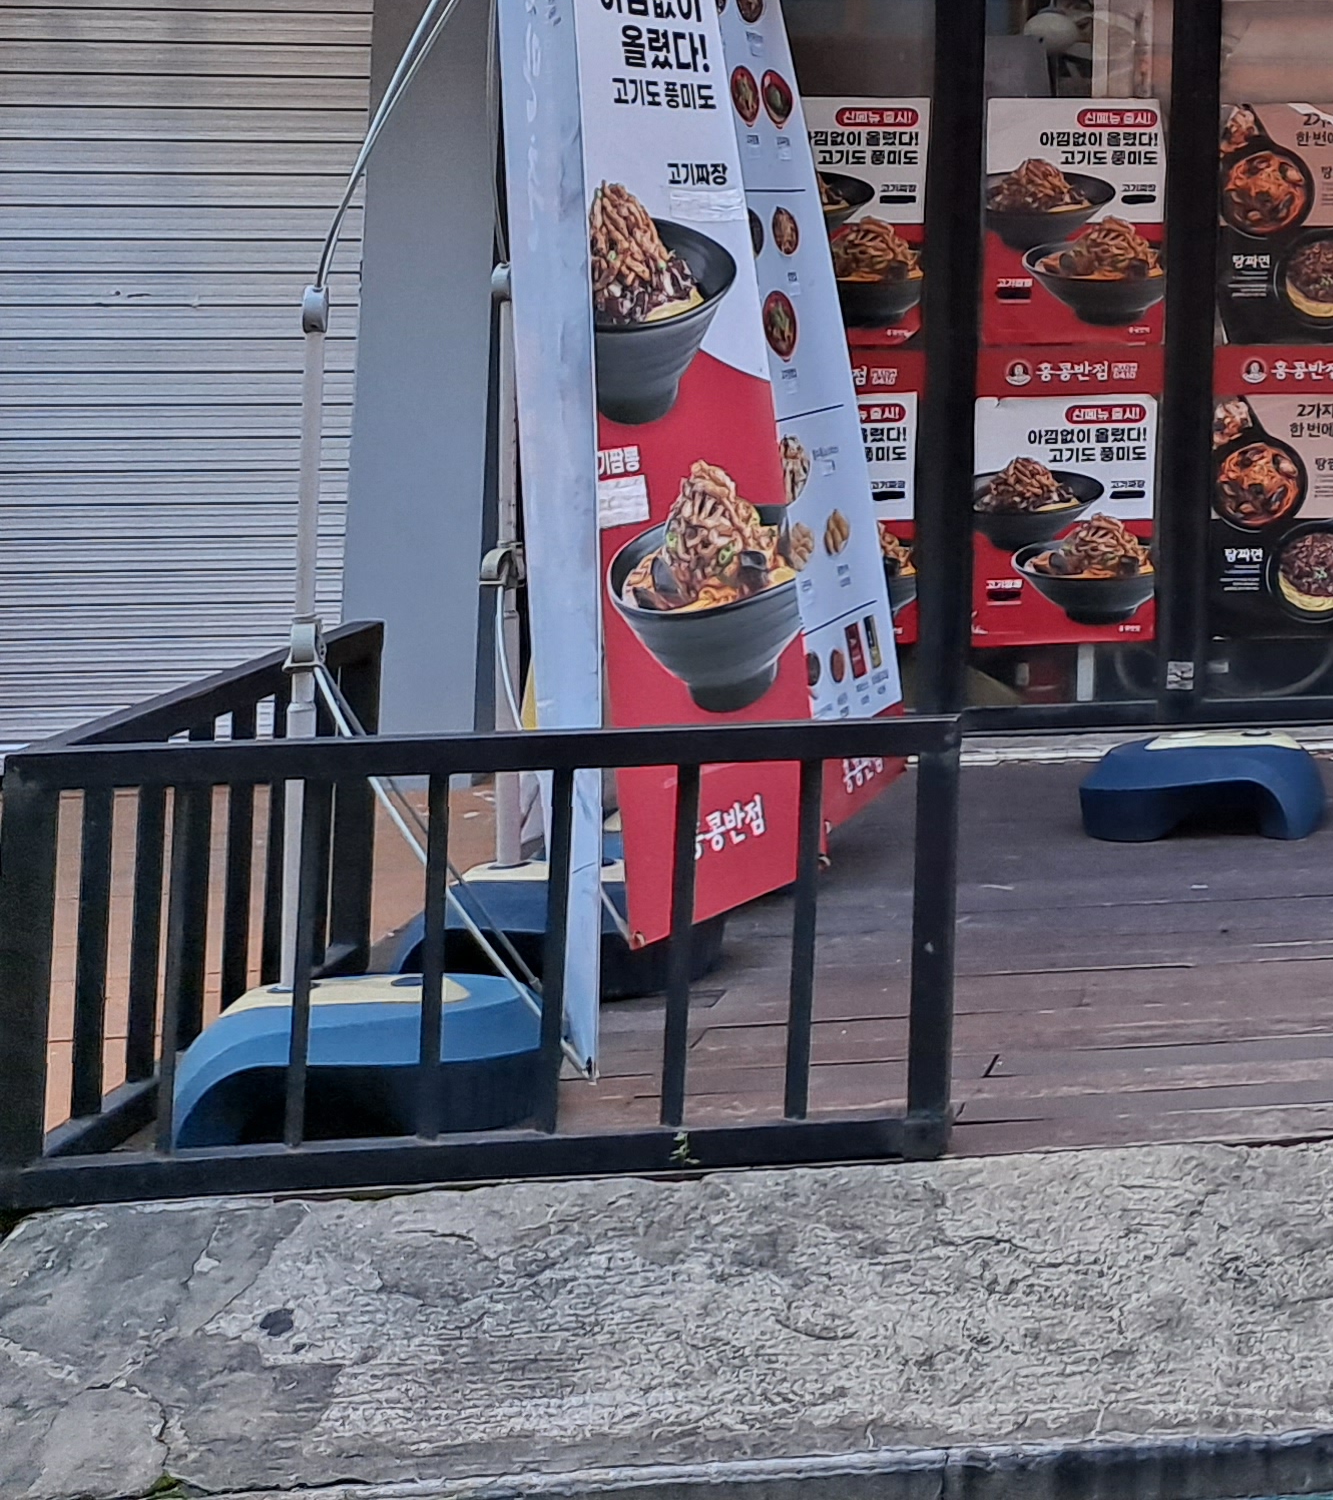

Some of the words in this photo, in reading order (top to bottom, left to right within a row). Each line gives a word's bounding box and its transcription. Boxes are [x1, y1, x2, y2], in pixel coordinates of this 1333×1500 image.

[621, 25, 711, 73] 올렸다!
[612, 77, 661, 107] 고기도
[664, 81, 717, 111] 풍미도
[808, 131, 863, 148] 낌없이
[1040, 131, 1103, 148] 아낌없이
[1106, 130, 1159, 147] 올렸다!
[1296, 131, 1310, 146] 한
[818, 150, 869, 165] 고기도
[1060, 150, 1107, 165] 고기도
[1110, 150, 1158, 166] 풍미도
[666, 162, 728, 188] 고기짜장
[1035, 360, 1109, 382] 홍콩반점
[1027, 429, 1091, 445] 아낌없이
[1094, 428, 1147, 444] 올렸다!
[1289, 422, 1304, 438] 한
[1048, 448, 1097, 463] 고기도
[1099, 447, 1147, 463] 풍미도
